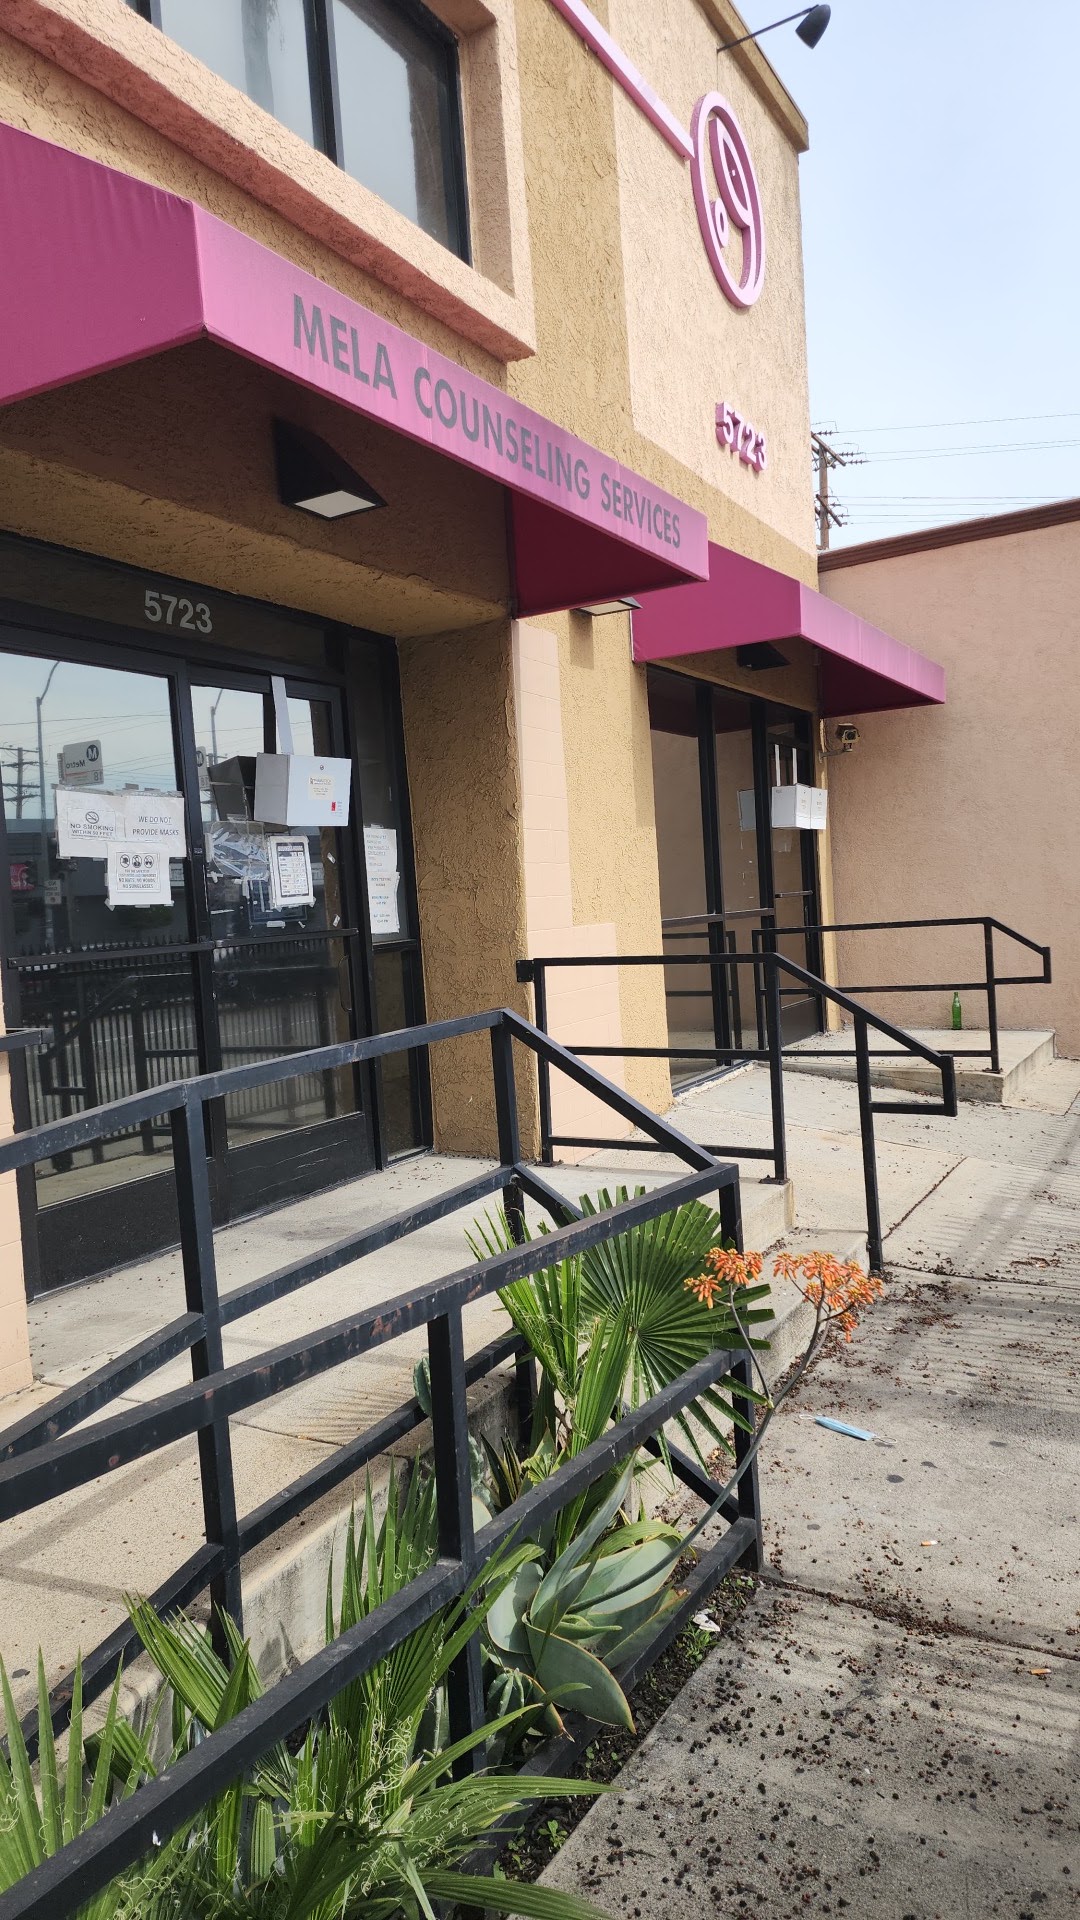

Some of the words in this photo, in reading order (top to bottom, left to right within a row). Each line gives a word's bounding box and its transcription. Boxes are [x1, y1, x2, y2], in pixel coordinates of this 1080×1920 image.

[293, 293, 398, 400] MELA
[413, 366, 591, 500] COUNSELING
[600, 472, 681, 550] SERVICES
[715, 401, 767, 473] 5723
[144, 590, 213, 634] 5723
[82, 824, 114, 832] SMOKING
[132, 828, 158, 836] PROVIDE
